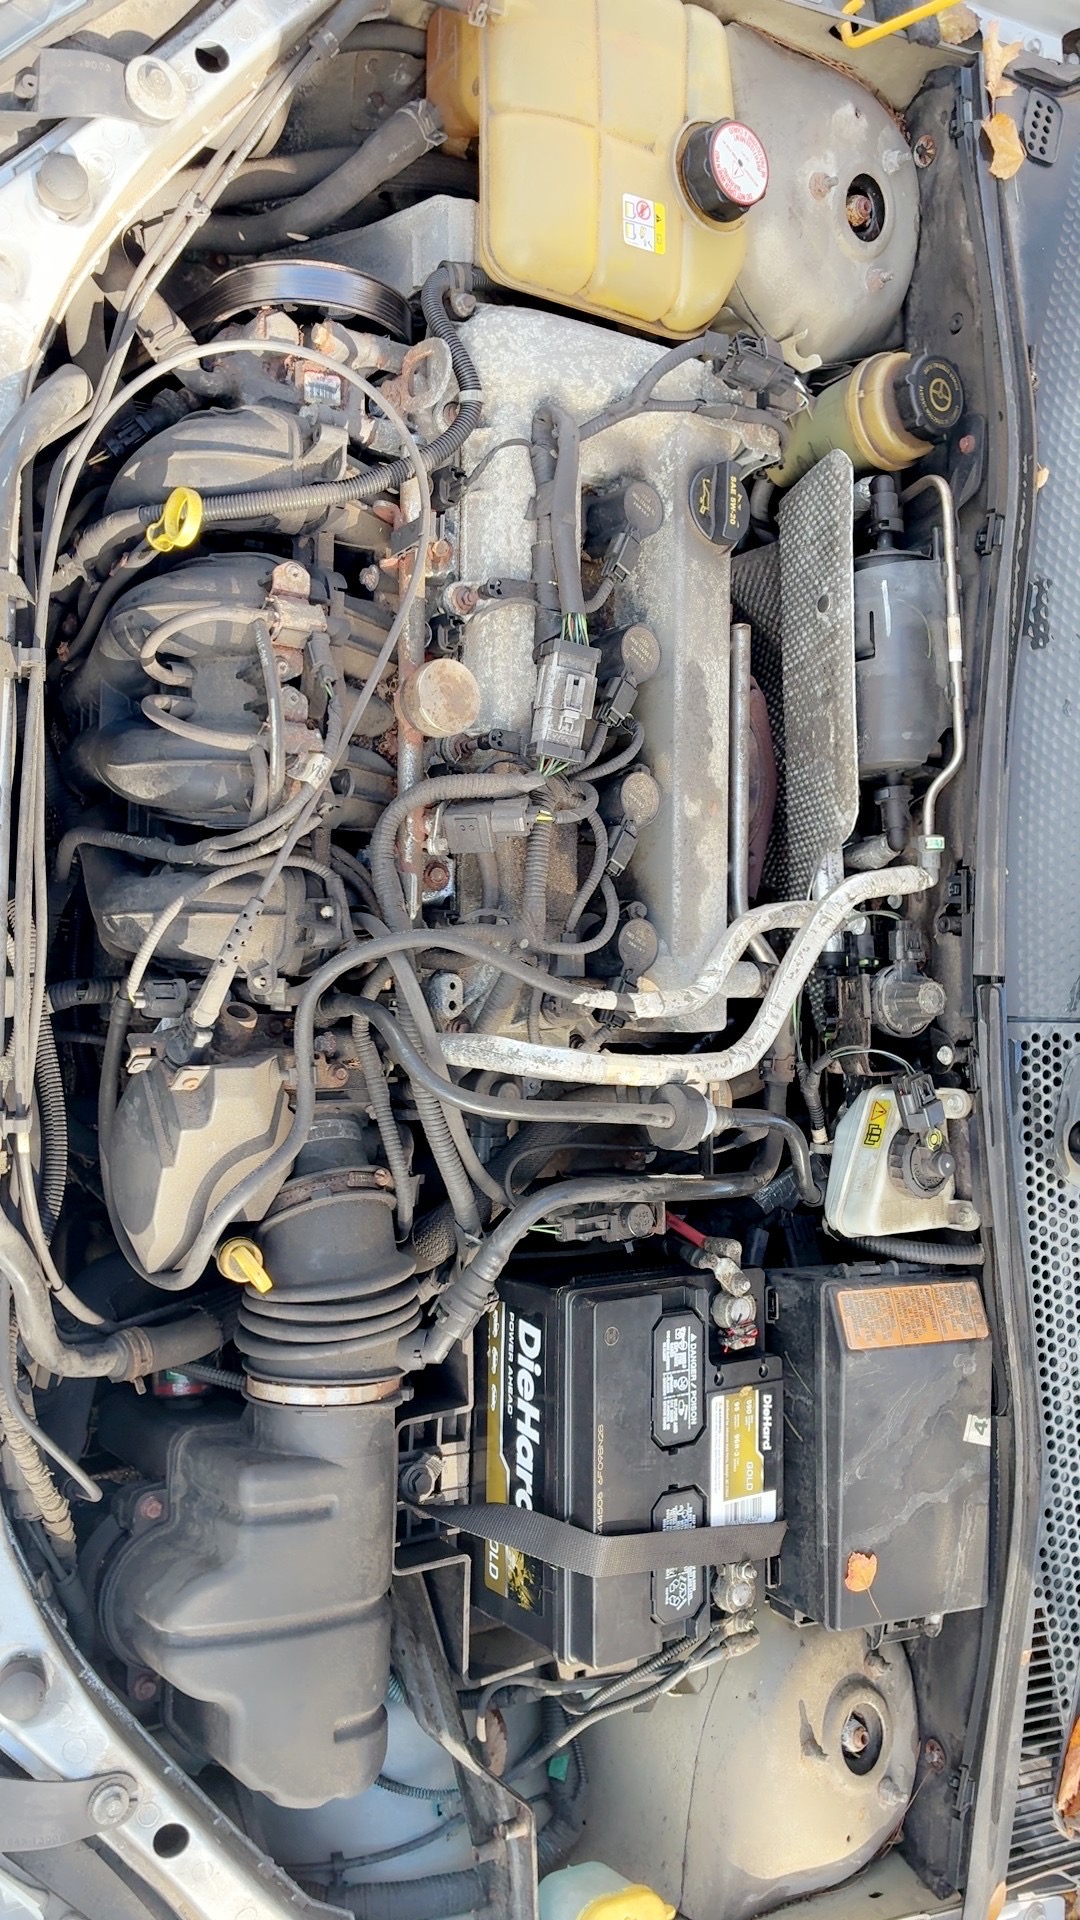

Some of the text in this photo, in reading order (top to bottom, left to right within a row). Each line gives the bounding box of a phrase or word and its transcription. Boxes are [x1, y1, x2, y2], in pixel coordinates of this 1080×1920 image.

[725, 181, 737, 197] OPEN
[737, 191, 745, 199] NOT
[934, 362, 950, 373] STEERING
[763, 1394, 773, 1451] DieHard
[974, 1421, 988, 1436] 4
[746, 1461, 754, 1491] GOLD
[488, 1539, 499, 1580] OLD
